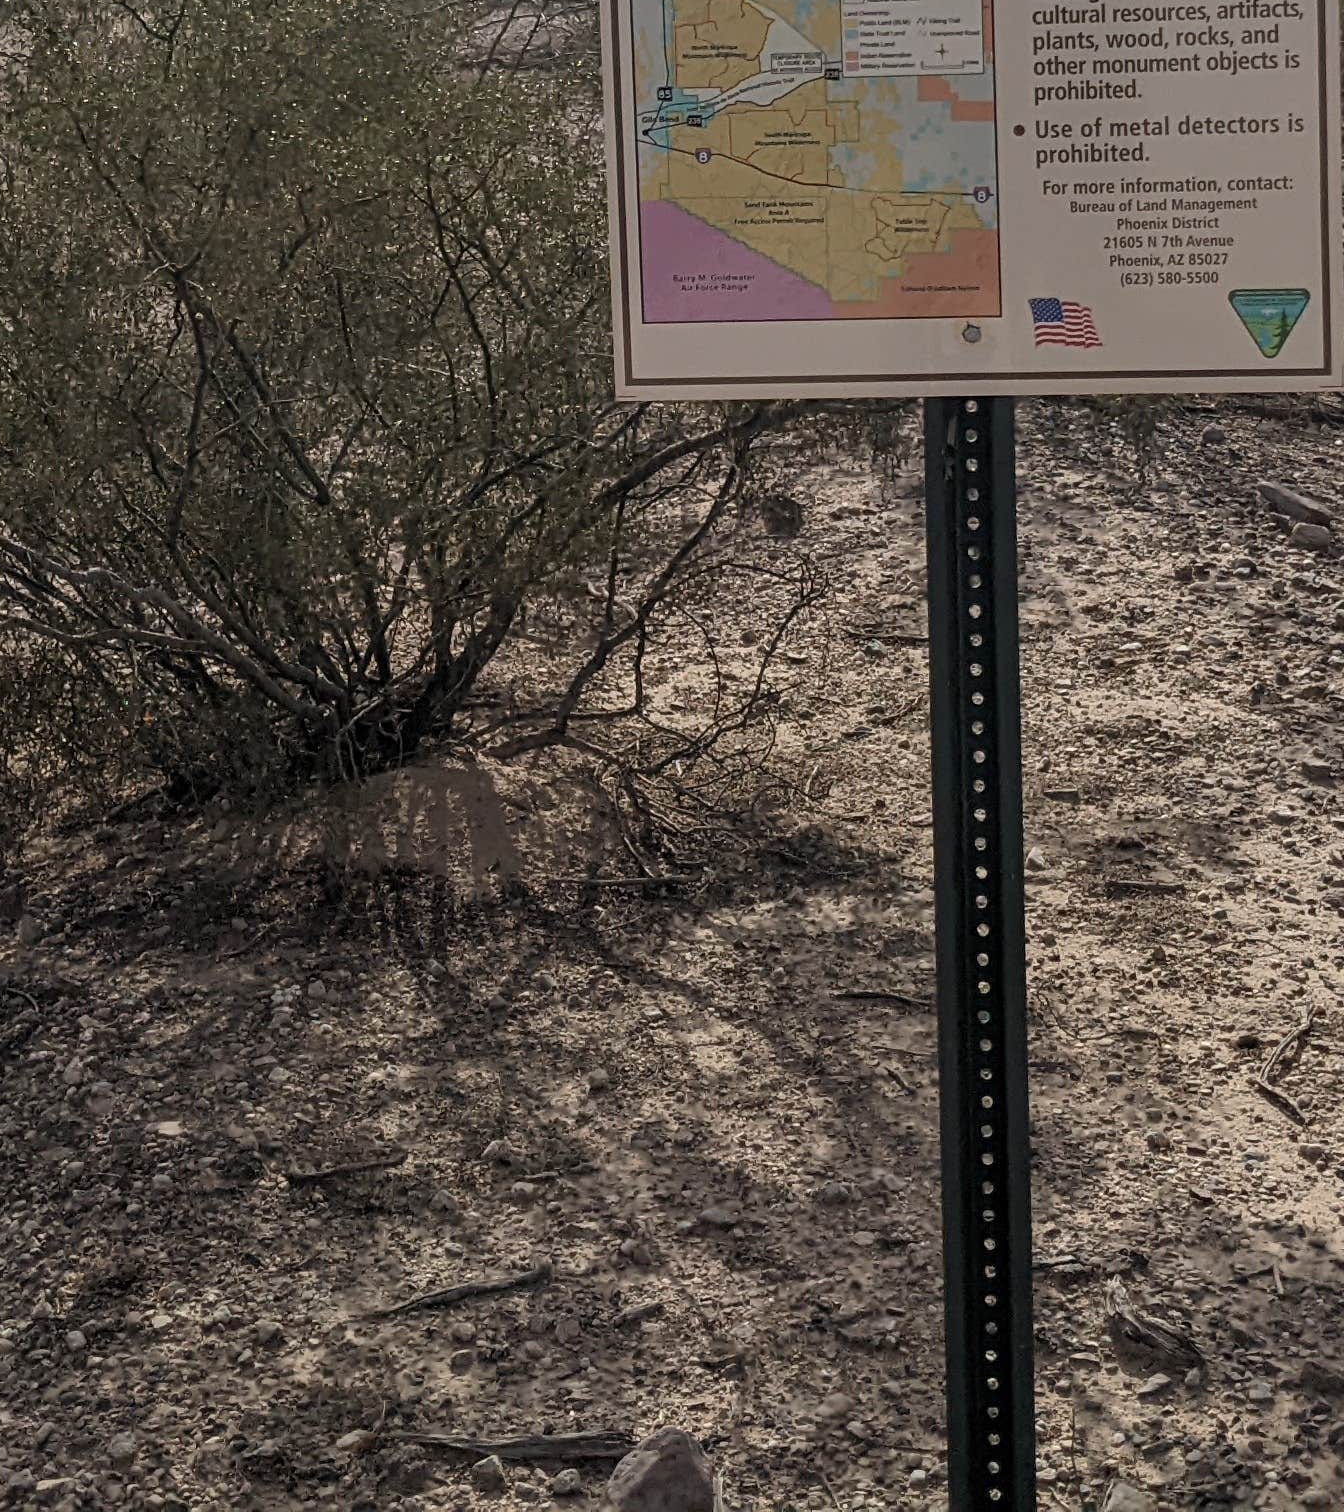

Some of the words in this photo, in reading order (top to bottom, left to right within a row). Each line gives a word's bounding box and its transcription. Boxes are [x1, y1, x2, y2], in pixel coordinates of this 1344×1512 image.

[1032, 2, 1106, 25] cultural
[1112, 5, 1211, 24] resources,
[1033, 30, 1099, 56] plants,
[1105, 26, 1169, 50] wood,
[1176, 25, 1234, 48] rocks,
[1241, 23, 1279, 45] and
[1033, 55, 1087, 76] other
[1092, 53, 1201, 75] monument
[1206, 50, 1279, 75] objects
[1285, 49, 1300, 69] is
[1034, 78, 1142, 106] prohibited.
[1035, 120, 1073, 139] Use
[1080, 116, 1102, 138] of
[1109, 115, 1170, 137] metal
[1178, 115, 1280, 135] detectors
[1288, 113, 1304, 133] is
[1036, 141, 1150, 169] prohibited.
[1043, 180, 1068, 195] For
[1073, 182, 1115, 195] more
[1121, 176, 1222, 194] information,
[1227, 176, 1293, 191] contact:
[1070, 201, 1115, 213] Bureau
[1118, 198, 1134, 212] of
[1136, 198, 1167, 212] Land
[1171, 198, 1258, 214] Management
[1117, 216, 1168, 231] Phoenix
[1172, 216, 1220, 229] District
[1104, 236, 1143, 249] 21605
[1147, 236, 1157, 248] N
[1161, 235, 1183, 248] 7th
[1185, 235, 1234, 247] Avenue
[1109, 253, 1164, 268] Phoenix,
[1167, 253, 1185, 266] AZ
[1188, 252, 1229, 266] 85027
[1120, 272, 1154, 288] (623)
[1157, 271, 1219, 285] 580-5500
